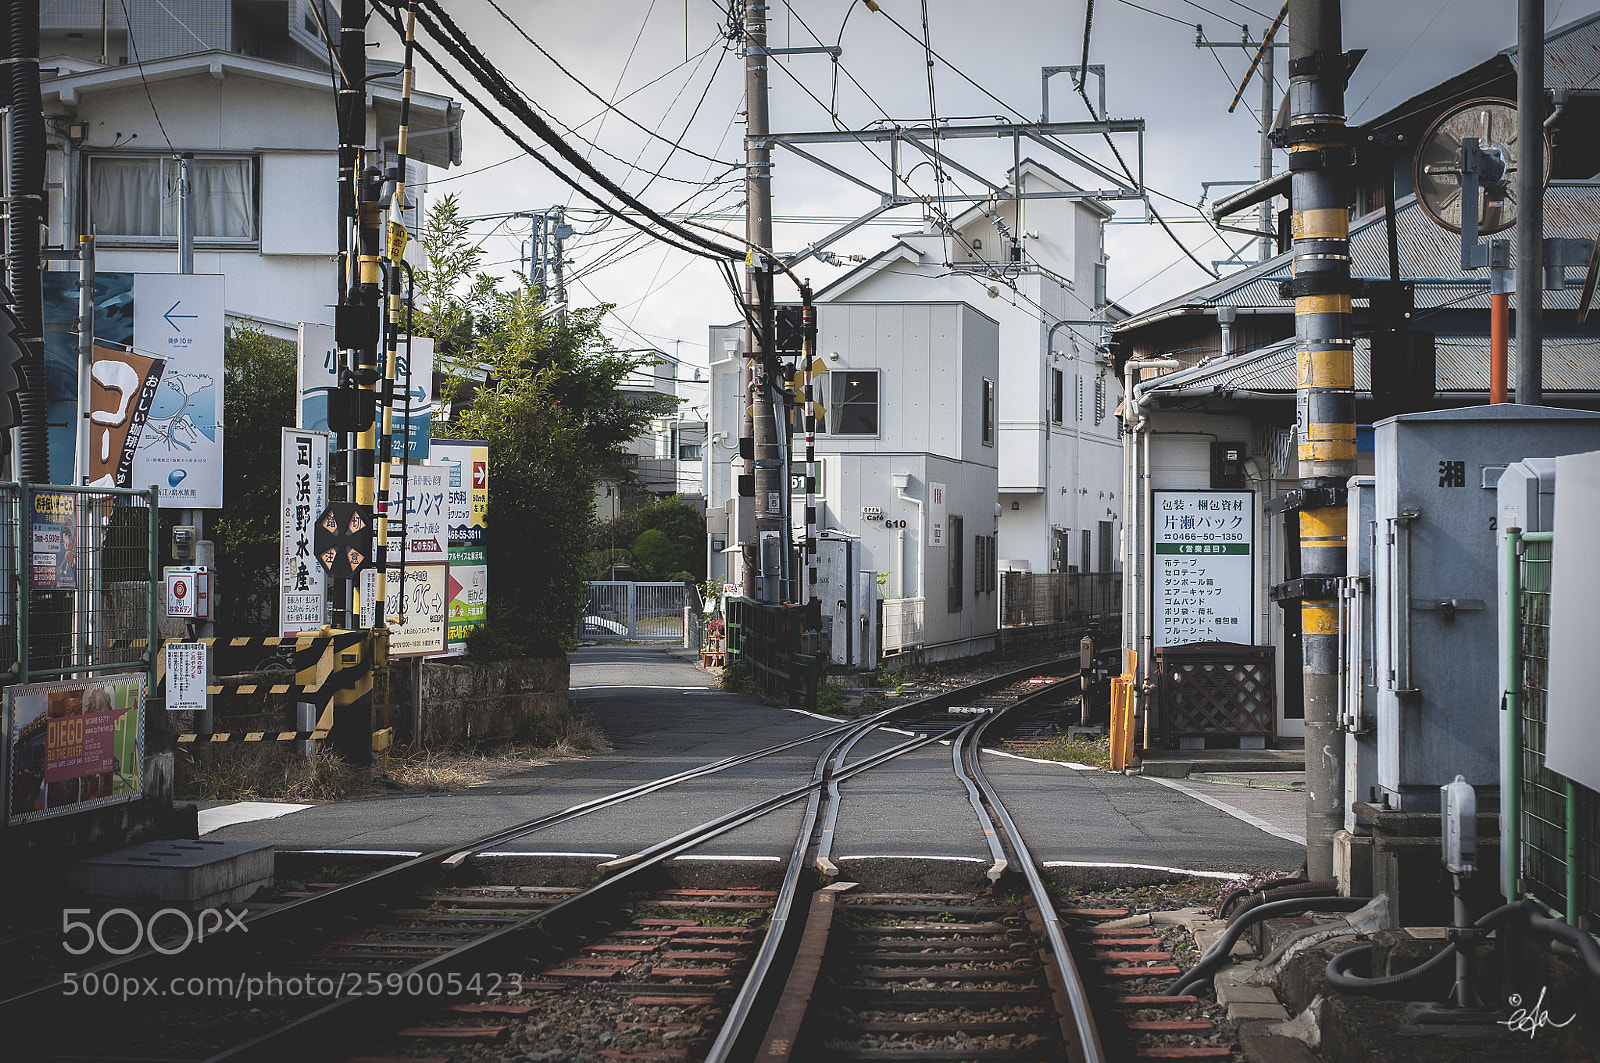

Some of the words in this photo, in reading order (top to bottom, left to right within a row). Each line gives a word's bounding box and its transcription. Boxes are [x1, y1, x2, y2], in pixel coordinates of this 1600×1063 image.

[1438, 461, 1466, 488] 湘
[1161, 499, 1244, 511] 包装・梱包資材
[448, 510, 470, 519] クリニック
[885, 519, 907, 529] 610
[1163, 515, 1243, 530] 片瀬パック
[294, 473, 311, 591] 浜野水産
[1172, 533, 1243, 541] 0466-50-1350
[1164, 559, 1197, 567] 布テープ
[1164, 578, 1214, 586] ダンボール箱
[1164, 588, 1222, 596] エアーキャップ
[47, 718, 83, 749] DIEGO
[67, 745, 83, 758] RIVER
